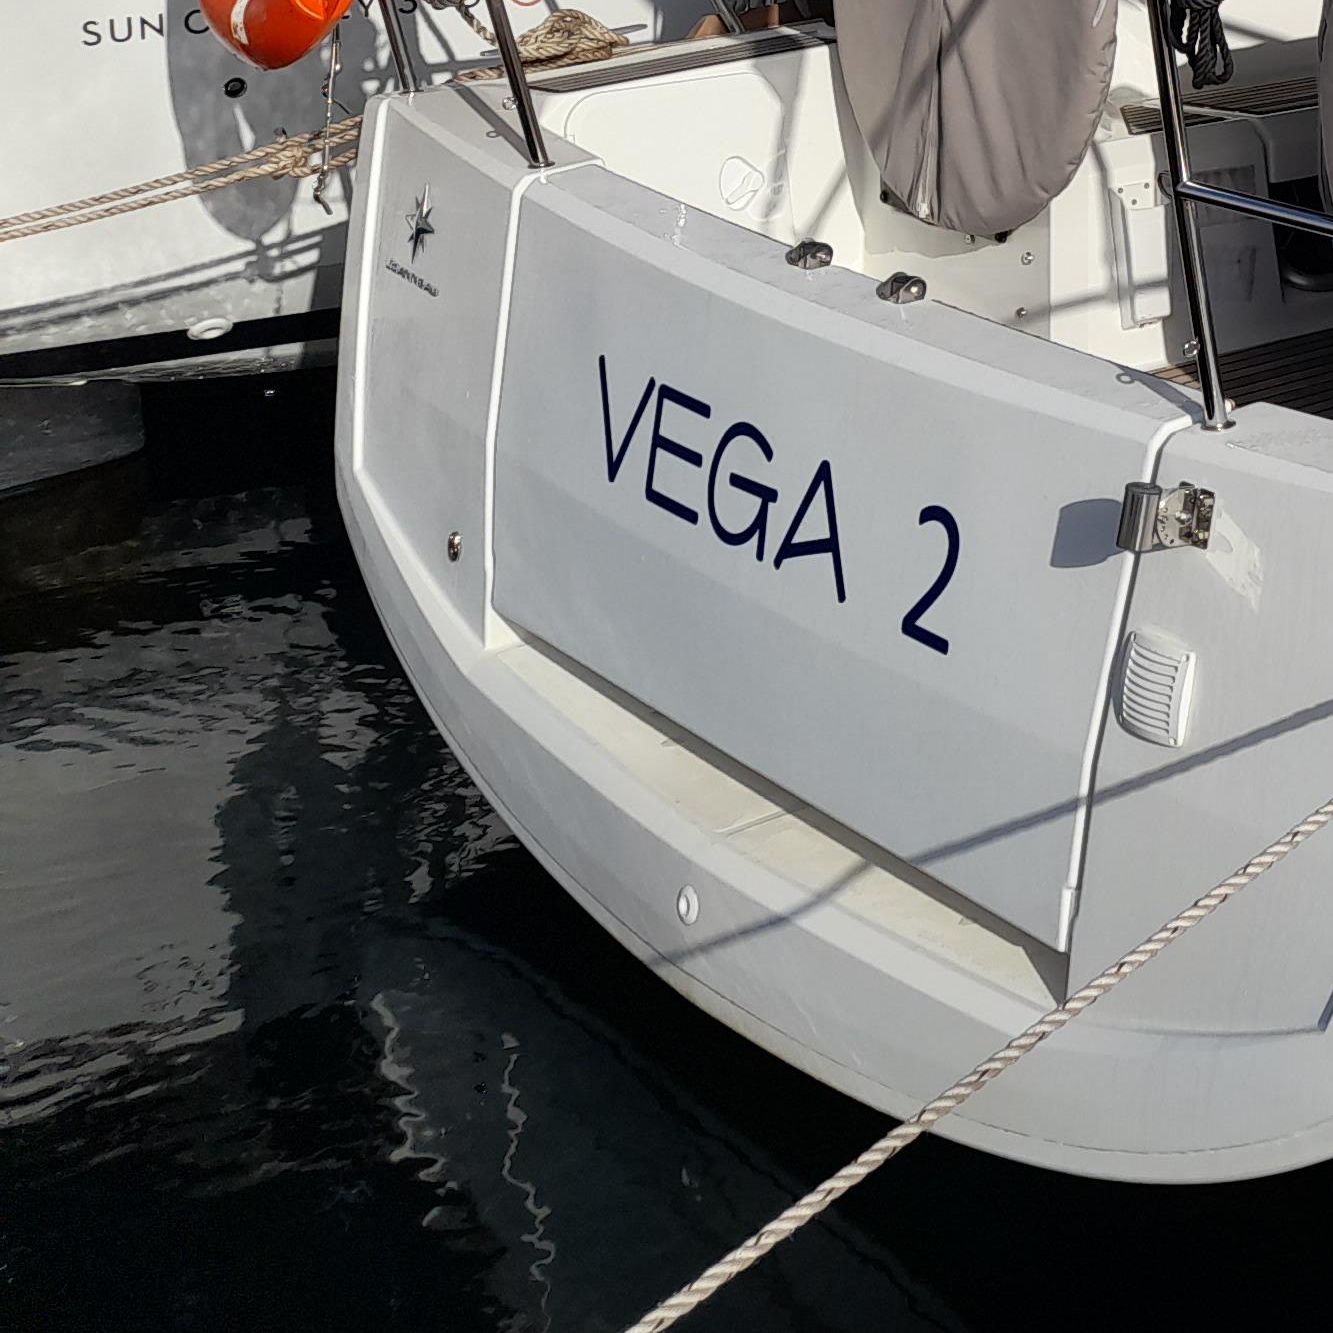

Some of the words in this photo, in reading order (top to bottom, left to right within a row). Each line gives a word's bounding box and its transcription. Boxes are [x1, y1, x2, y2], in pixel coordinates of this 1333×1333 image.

[81, 13, 165, 46] SUN
[598, 353, 847, 604] VEGA
[900, 504, 961, 656] 2
